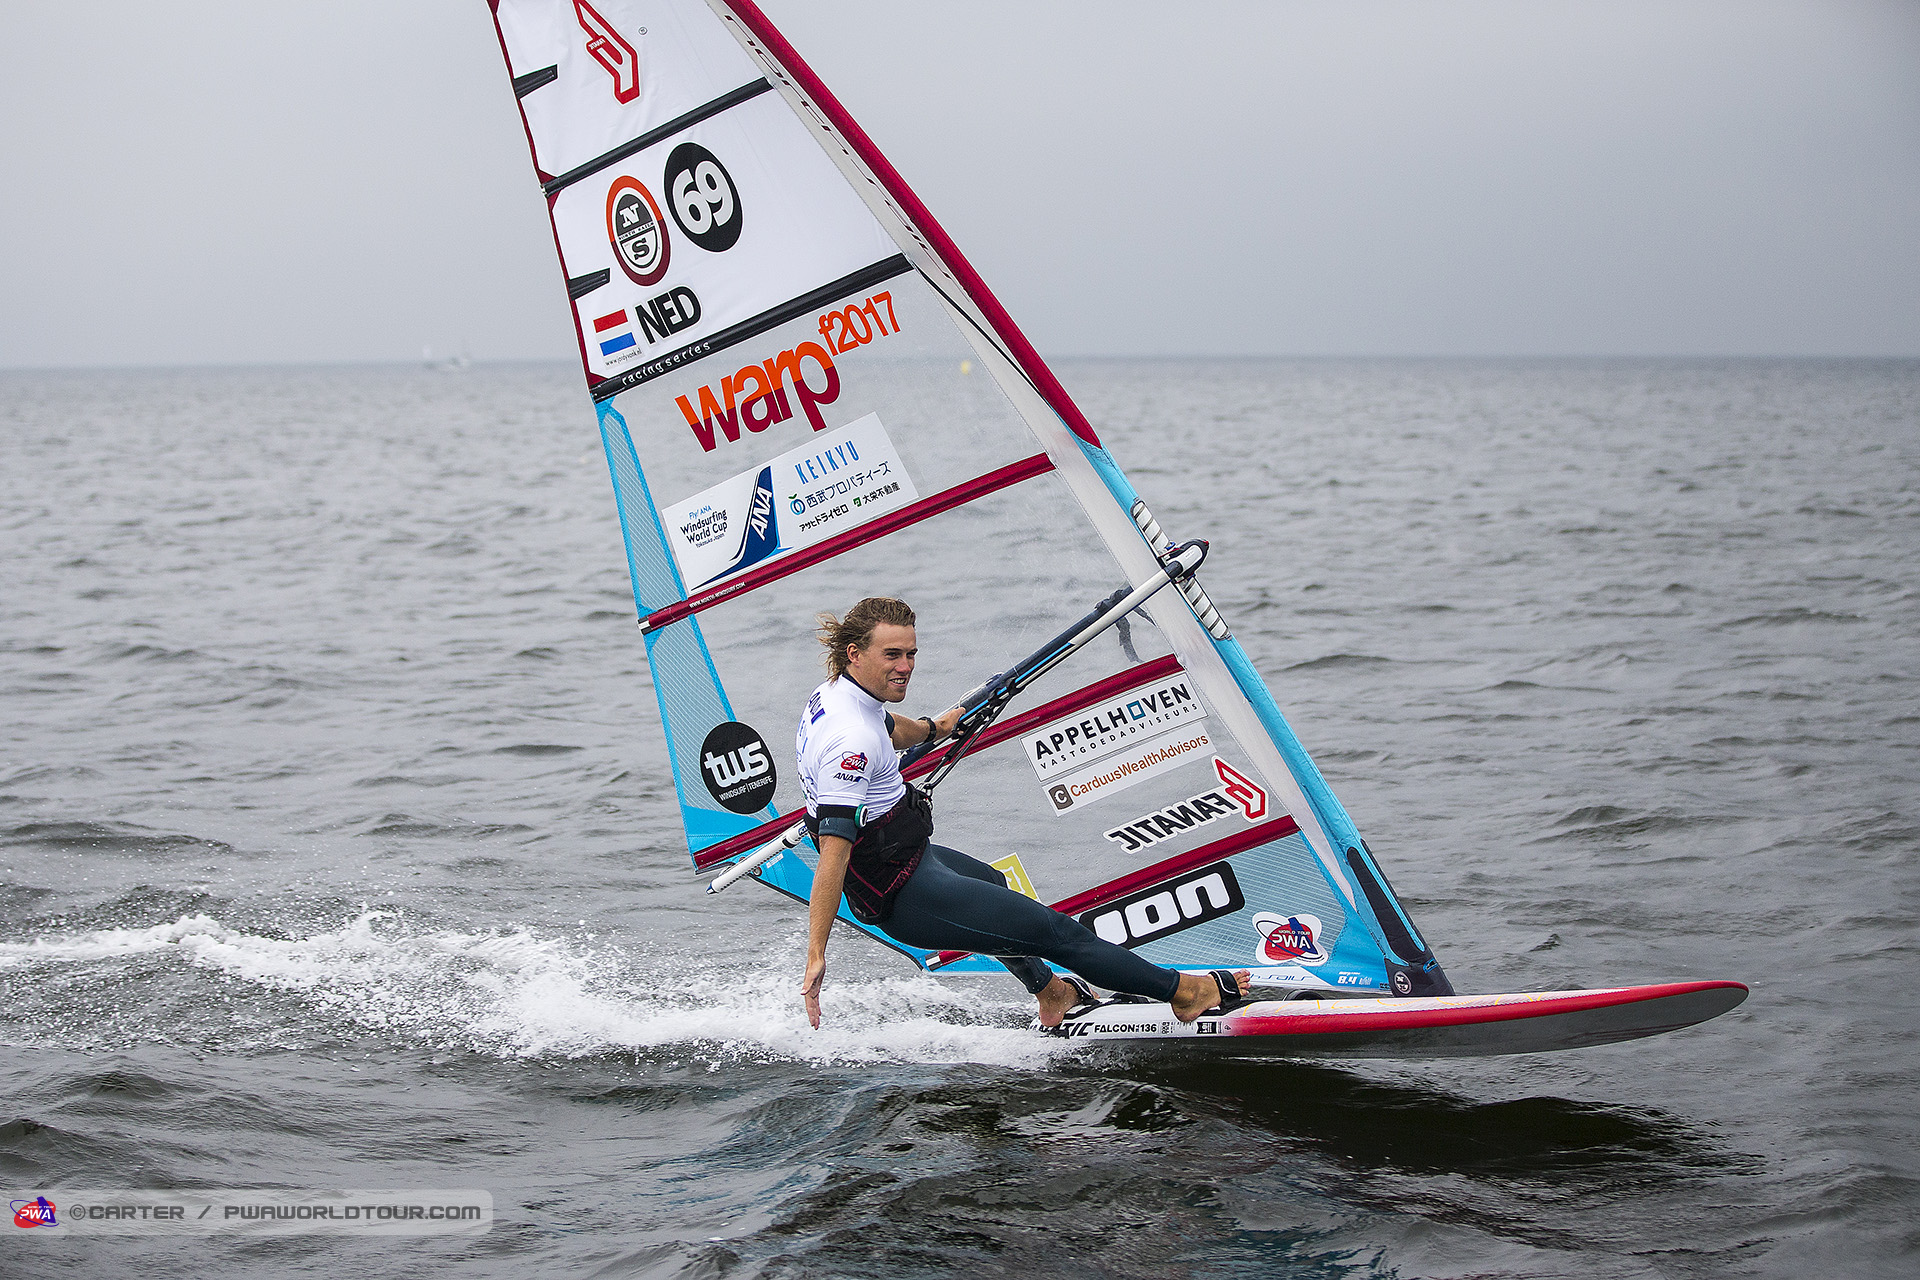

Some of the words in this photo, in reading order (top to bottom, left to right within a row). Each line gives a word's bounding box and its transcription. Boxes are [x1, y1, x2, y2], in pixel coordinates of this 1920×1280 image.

[619, 203, 640, 228] N
[672, 160, 734, 235] 69
[631, 238, 650, 261] S
[635, 286, 701, 344] NED
[622, 361, 665, 385] racing
[666, 342, 711, 366] series
[674, 341, 840, 453] warp
[817, 290, 901, 357] f2017
[795, 440, 859, 485] KEIKYU
[680, 509, 728, 535] Windsurfing
[686, 529, 711, 544] World
[712, 521, 728, 534] Cup
[751, 486, 773, 541] ANA
[1035, 683, 1192, 760] APPELHOVEN
[1040, 703, 1198, 770] VASTGOEDADVISEURS
[1070, 734, 1209, 797] CarduusWealthAdvisors
[1271, 933, 1311, 949] PWA
[1337, 975, 1358, 985] 8.4
[1094, 1024, 1136, 1033] FALCON
[1140, 1023, 1157, 1033] 136
